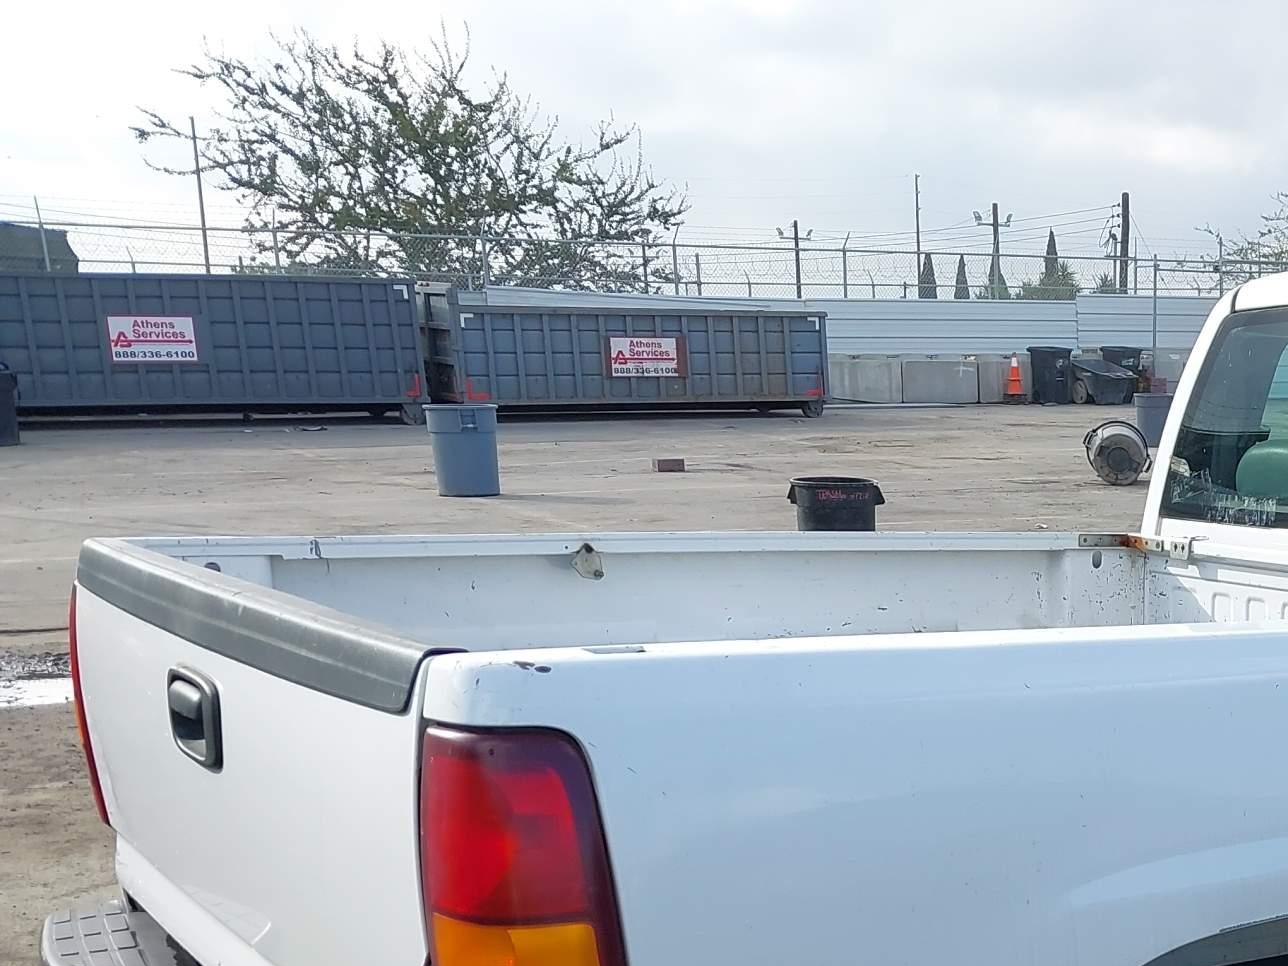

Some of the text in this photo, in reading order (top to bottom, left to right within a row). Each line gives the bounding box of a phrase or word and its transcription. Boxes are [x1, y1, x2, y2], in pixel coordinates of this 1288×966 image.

[132, 319, 175, 329] Athens
[132, 329, 186, 339] Services
[629, 340, 662, 349] Athens
[114, 350, 195, 359] 888/336-6100
[629, 348, 670, 357] Services
